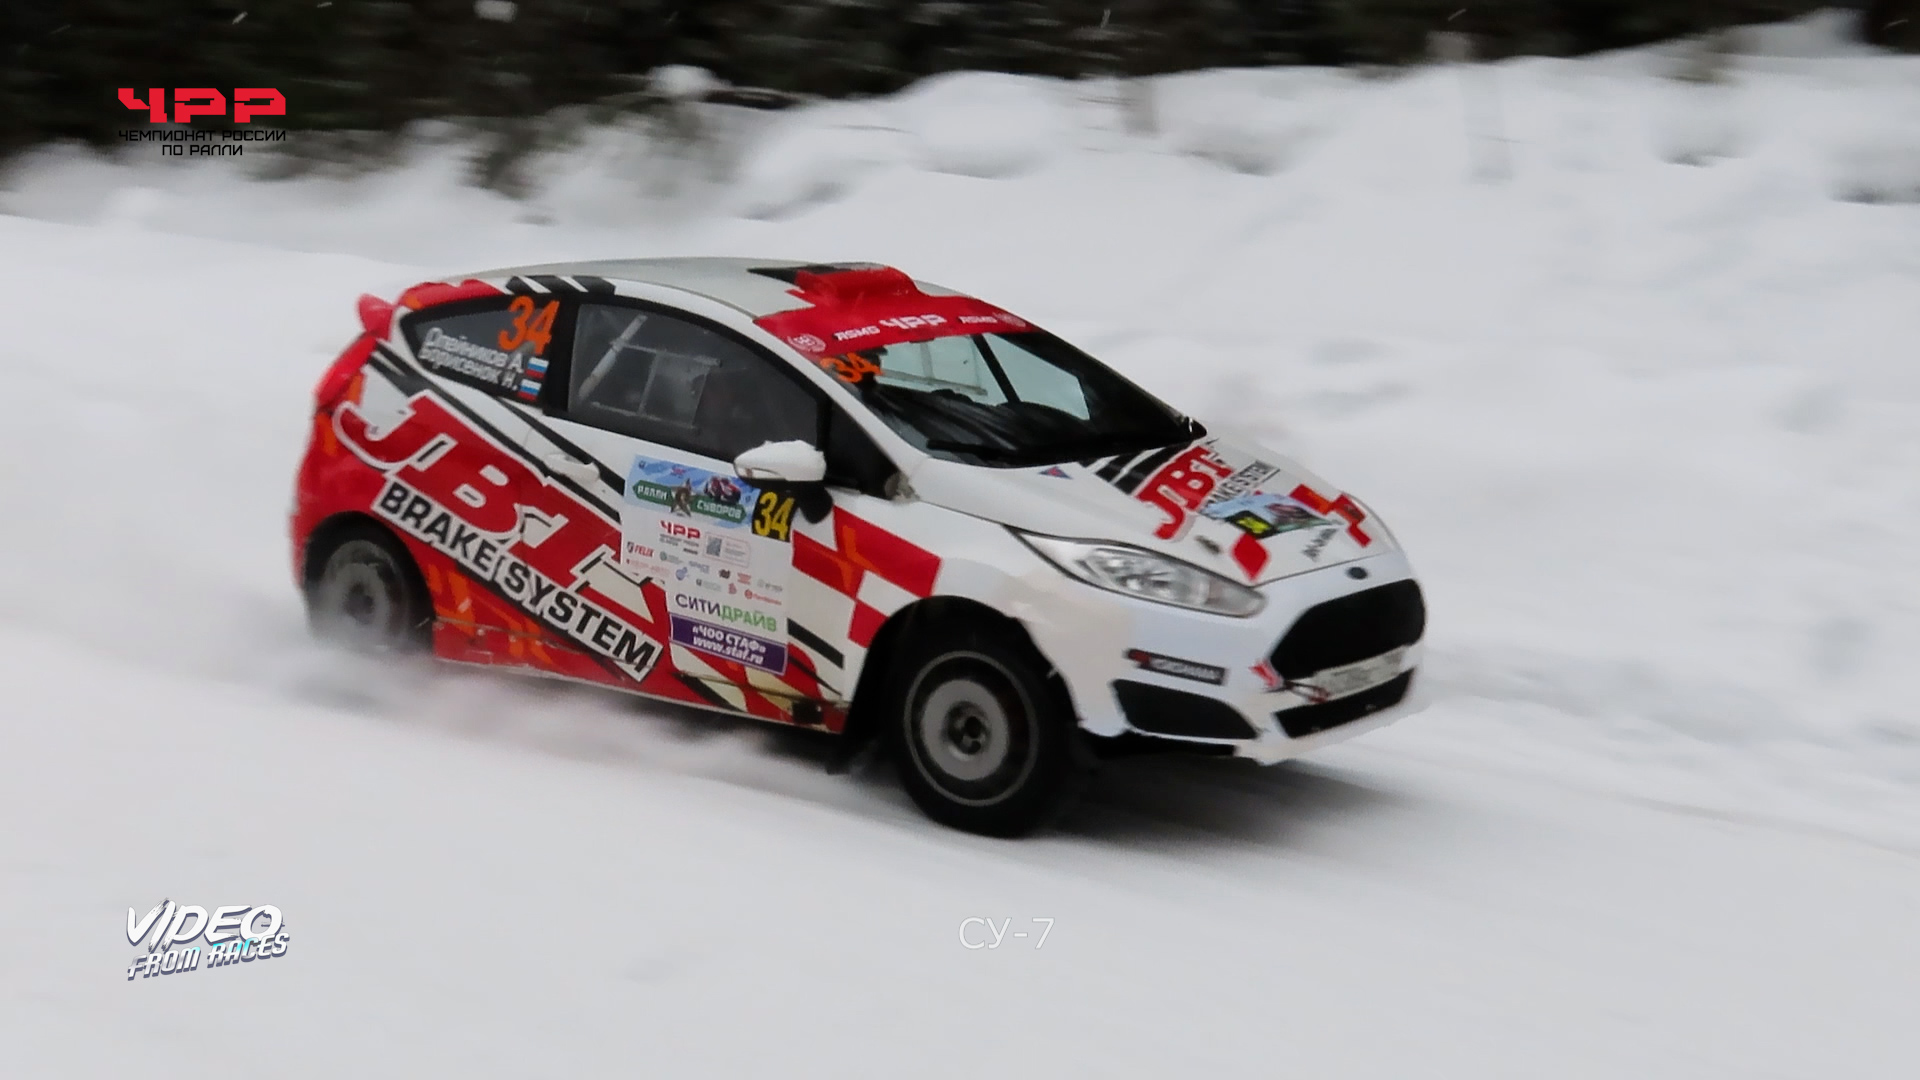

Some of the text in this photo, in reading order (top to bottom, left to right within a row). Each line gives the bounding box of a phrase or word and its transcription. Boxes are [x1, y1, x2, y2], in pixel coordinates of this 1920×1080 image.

[498, 296, 560, 356] 34
[879, 313, 947, 330] ЧРР
[820, 352, 883, 383] 34
[332, 388, 625, 592] JBT
[637, 485, 742, 519] РАЛЛИ СУВОРОВ
[1135, 444, 1234, 541] JBT
[660, 519, 701, 539] ЧРР
[754, 491, 795, 541] 34
[380, 481, 657, 674] BRAKE SYSTEM
[675, 593, 777, 632] СИТИДРАЙВ
[692, 636, 764, 665] www.staf.ru
